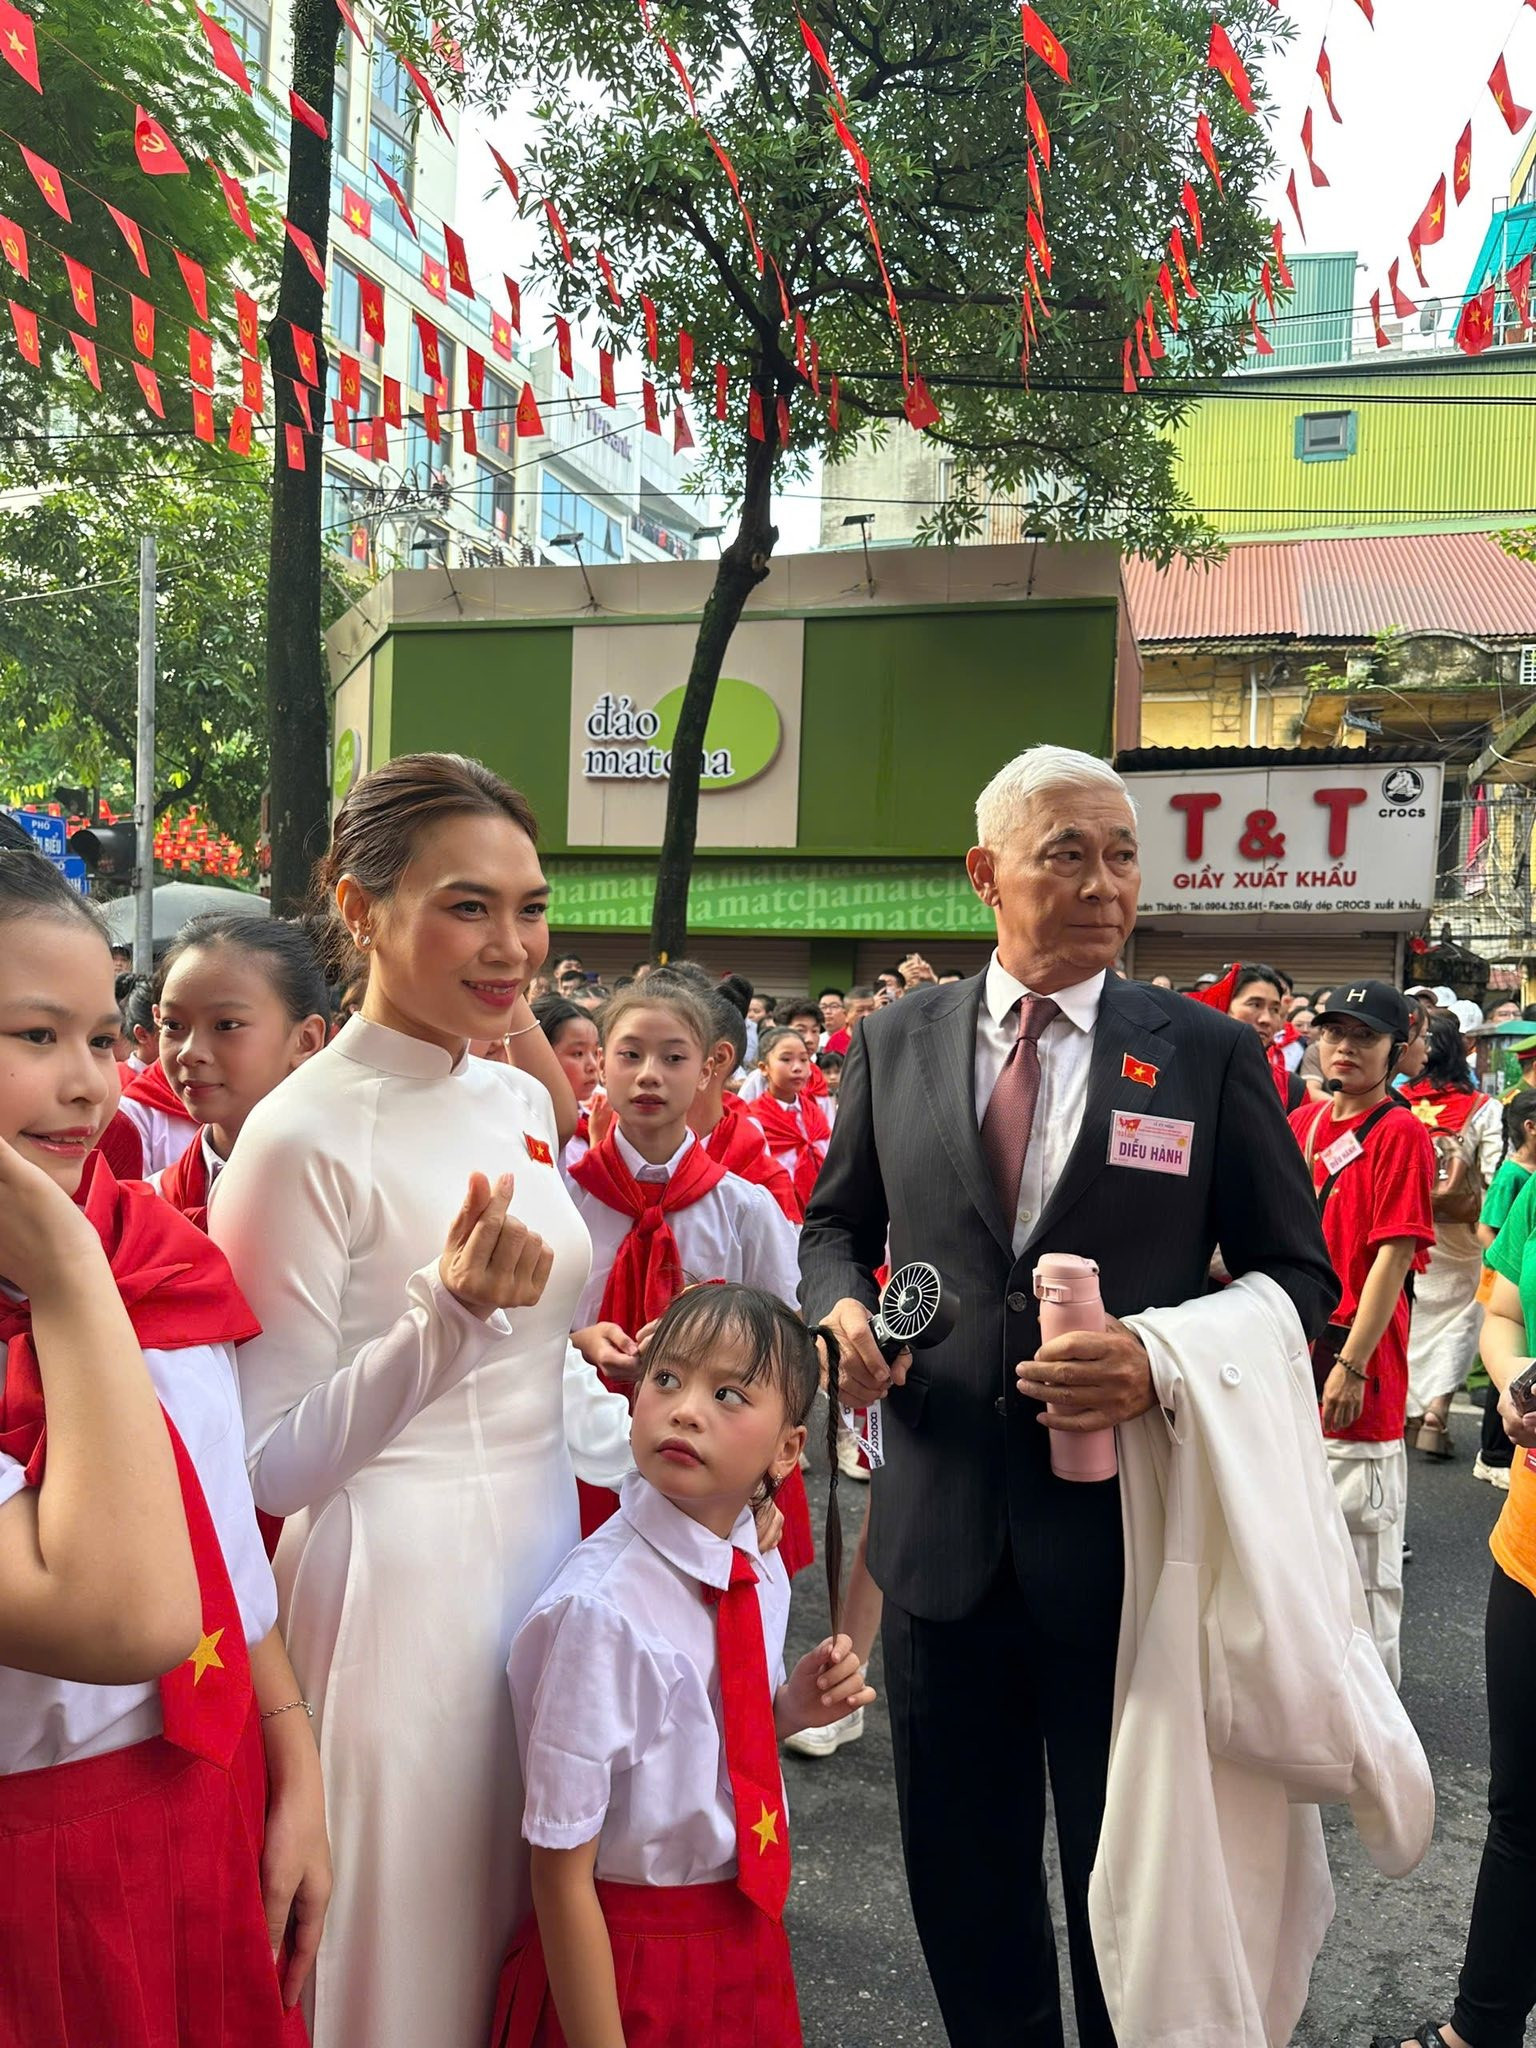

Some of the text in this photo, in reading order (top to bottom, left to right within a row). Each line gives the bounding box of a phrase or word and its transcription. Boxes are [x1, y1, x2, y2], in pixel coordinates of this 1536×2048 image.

[587, 694, 659, 738] đảo
[1378, 807, 1426, 818] crocs
[1170, 788, 1367, 862] T & T
[1233, 862, 1288, 889] XUẤT
[1296, 862, 1357, 888] KHẨU
[1336, 901, 1371, 910] CROCS
[1346, 989, 1368, 1003] H
[1150, 1144, 1183, 1165] HÀNH
